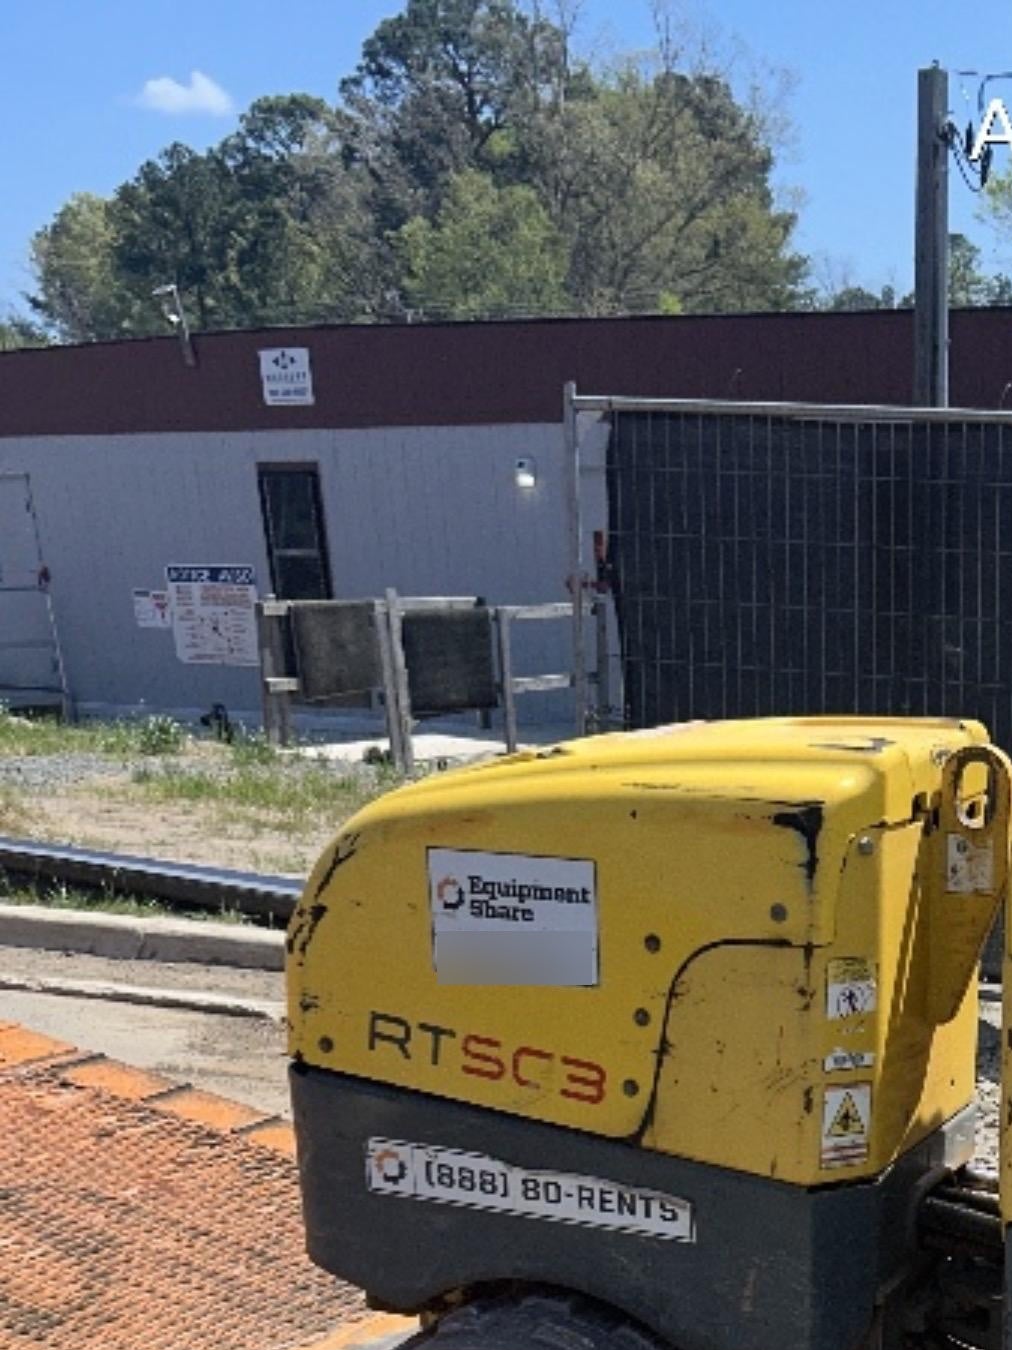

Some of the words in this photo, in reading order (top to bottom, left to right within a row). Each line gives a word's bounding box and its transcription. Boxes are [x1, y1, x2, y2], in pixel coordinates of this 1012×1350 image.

[467, 875, 592, 904] Equipment
[468, 899, 535, 922] Share
[424, 1159, 510, 1198] (888)
[520, 1177, 679, 1224] 80-RENTS
